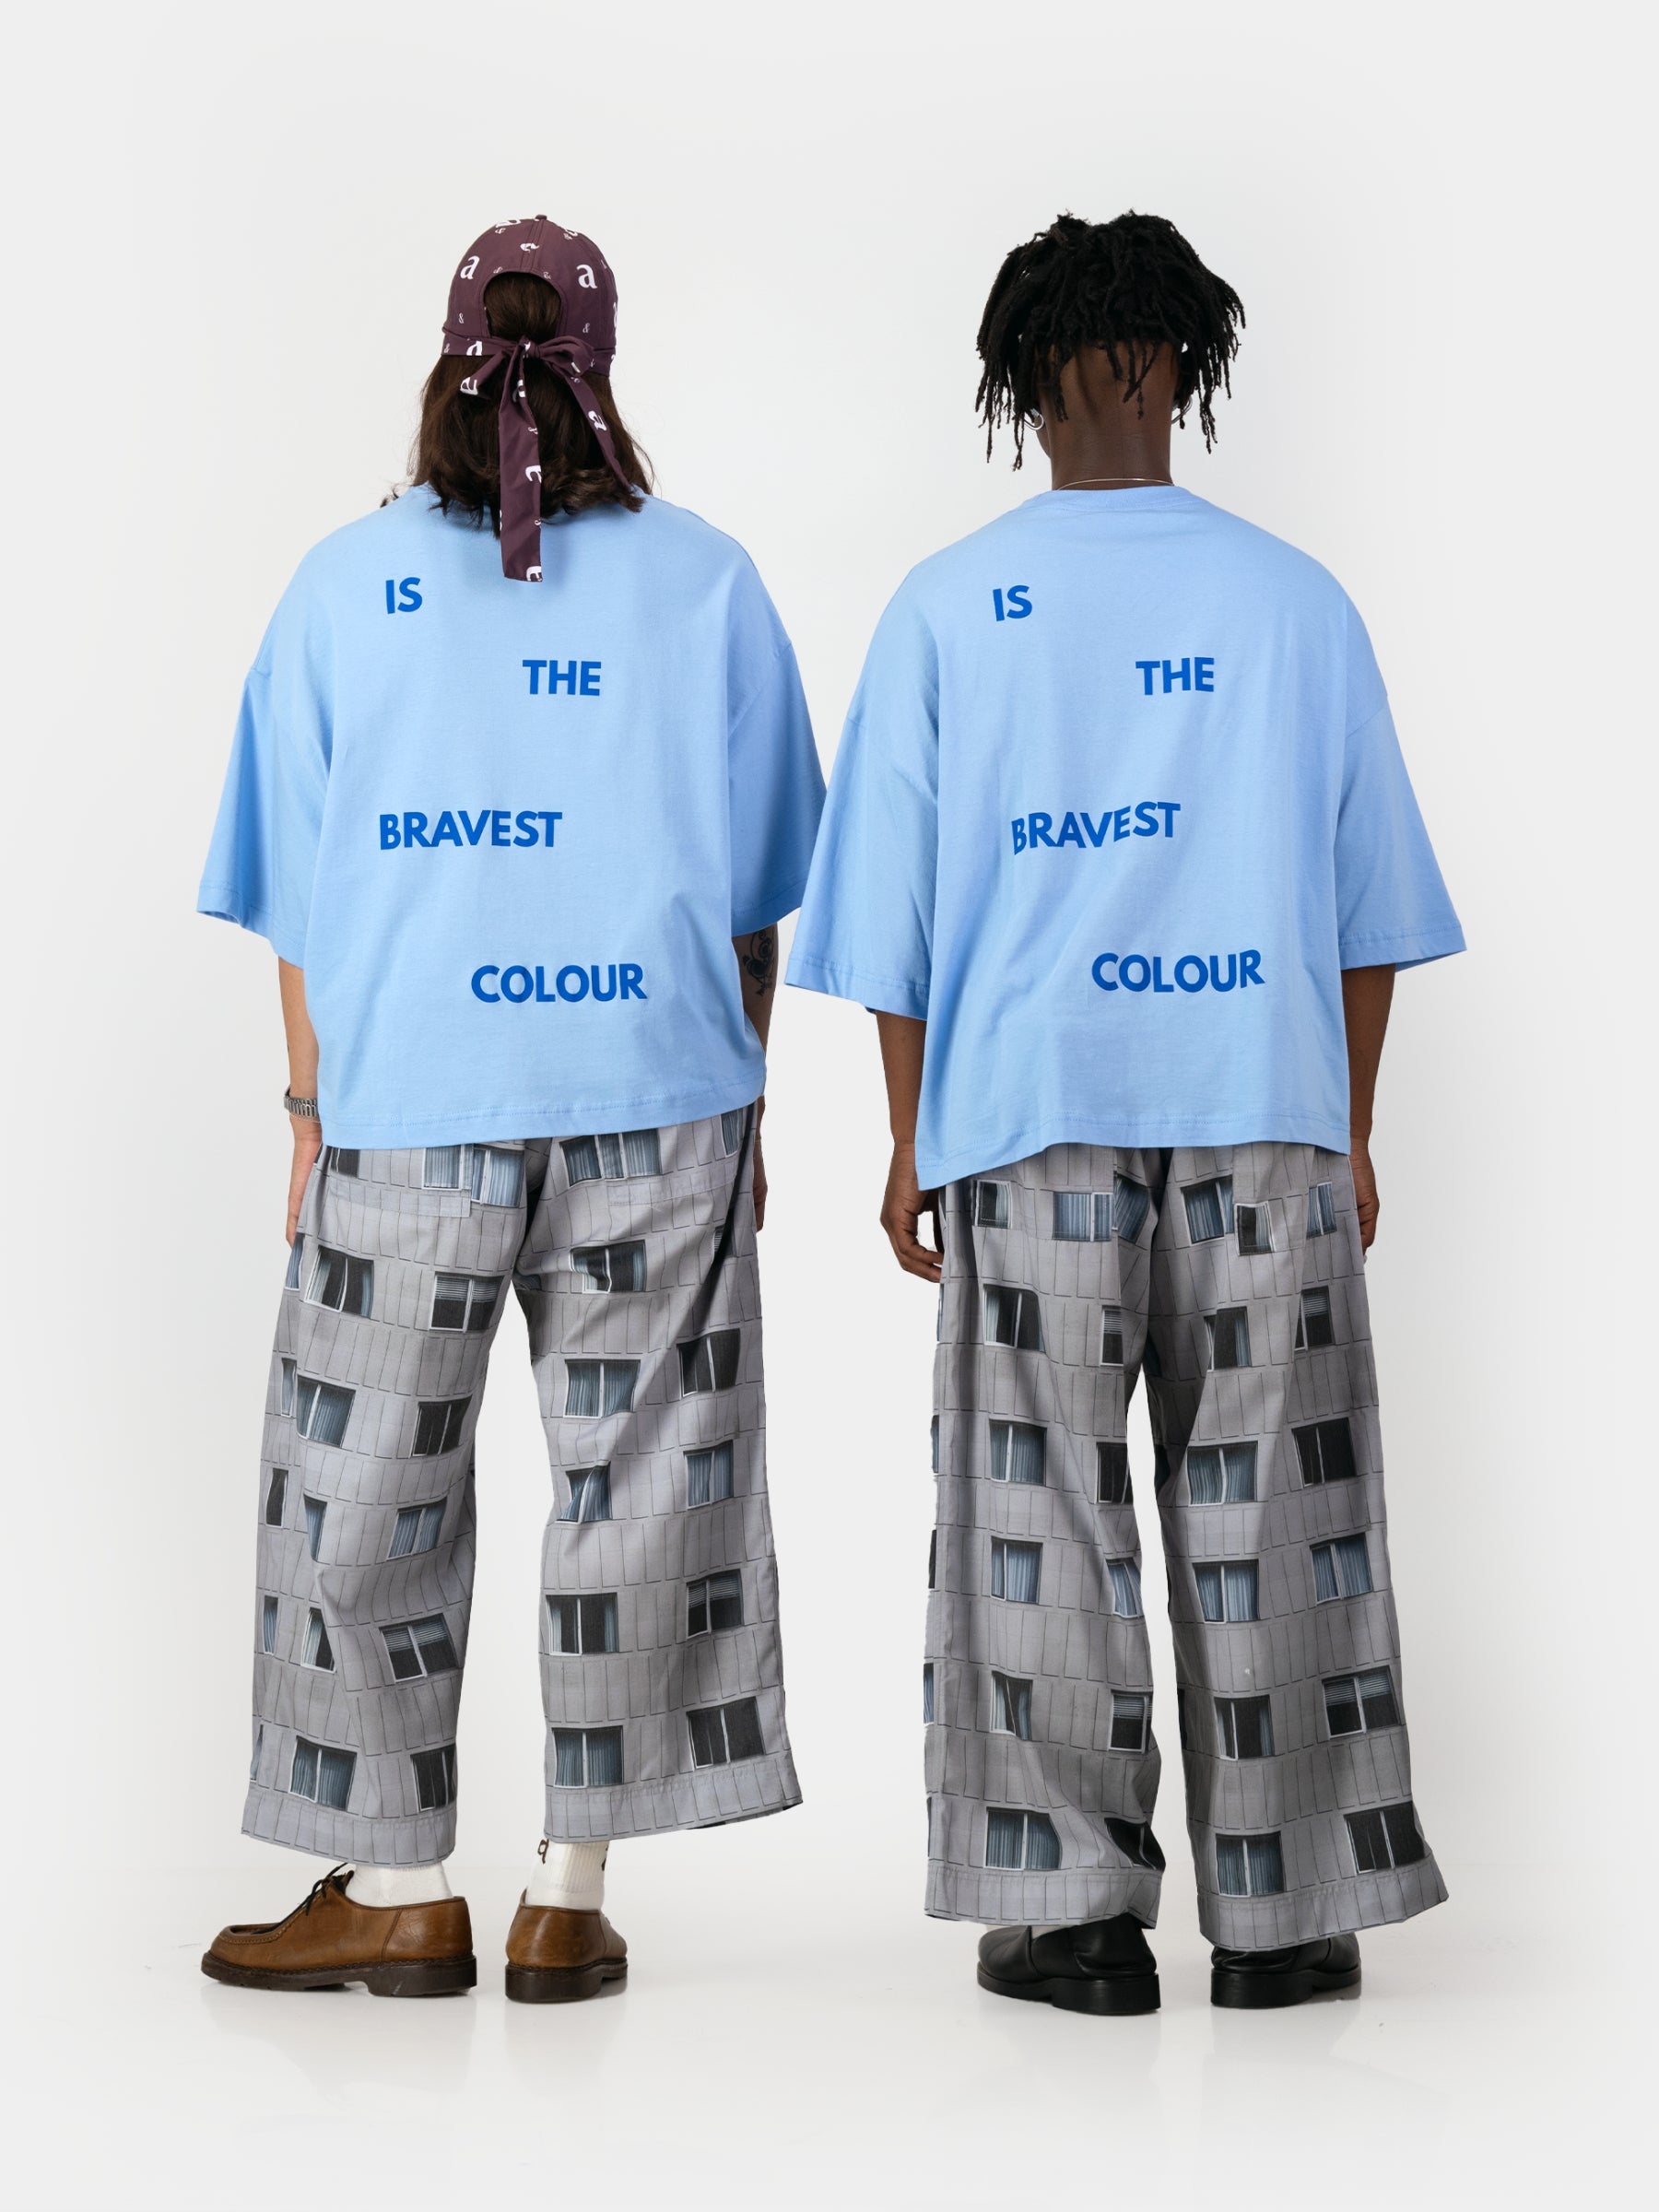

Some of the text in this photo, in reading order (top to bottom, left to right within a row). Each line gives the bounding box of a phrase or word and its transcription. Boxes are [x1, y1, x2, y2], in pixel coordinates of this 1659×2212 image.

[460, 255, 480, 280] a
[576, 265, 598, 289] a
[459, 313, 465, 324] &
[582, 323, 591, 334] &
[385, 577, 423, 615] IS
[993, 584, 1033, 622] IS
[522, 659, 602, 697] THE
[1135, 656, 1215, 696] THE
[379, 809, 563, 851] BRAVEST
[1011, 801, 1182, 855] BRAVEST
[471, 963, 648, 1004] COLOUR
[1091, 949, 1265, 994] COLOUR
